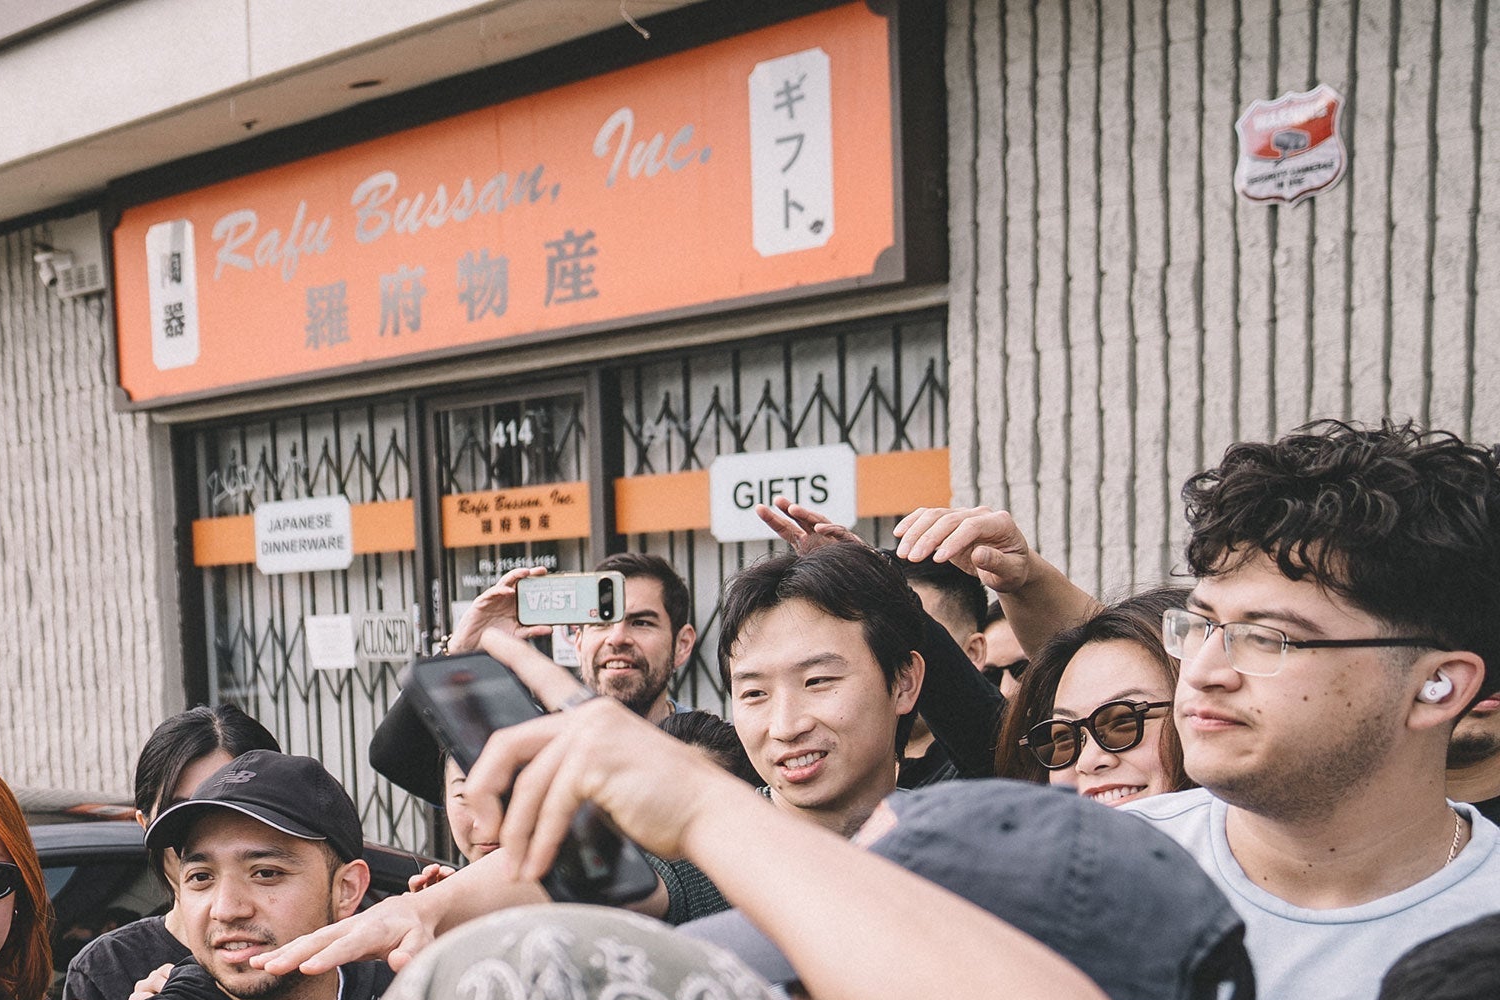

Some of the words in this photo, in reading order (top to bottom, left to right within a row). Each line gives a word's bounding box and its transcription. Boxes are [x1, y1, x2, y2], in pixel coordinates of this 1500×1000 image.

[773, 73, 807, 230] ギフト
[211, 199, 333, 283] Rafu
[592, 106, 712, 189] Inc.
[304, 229, 600, 352] 羅府物産
[491, 417, 534, 448] 414
[732, 473, 830, 510] GIFTS
[266, 512, 334, 533] JAPANESE
[261, 535, 346, 556] DINNERWARE
[362, 617, 409, 656] CLOSED
